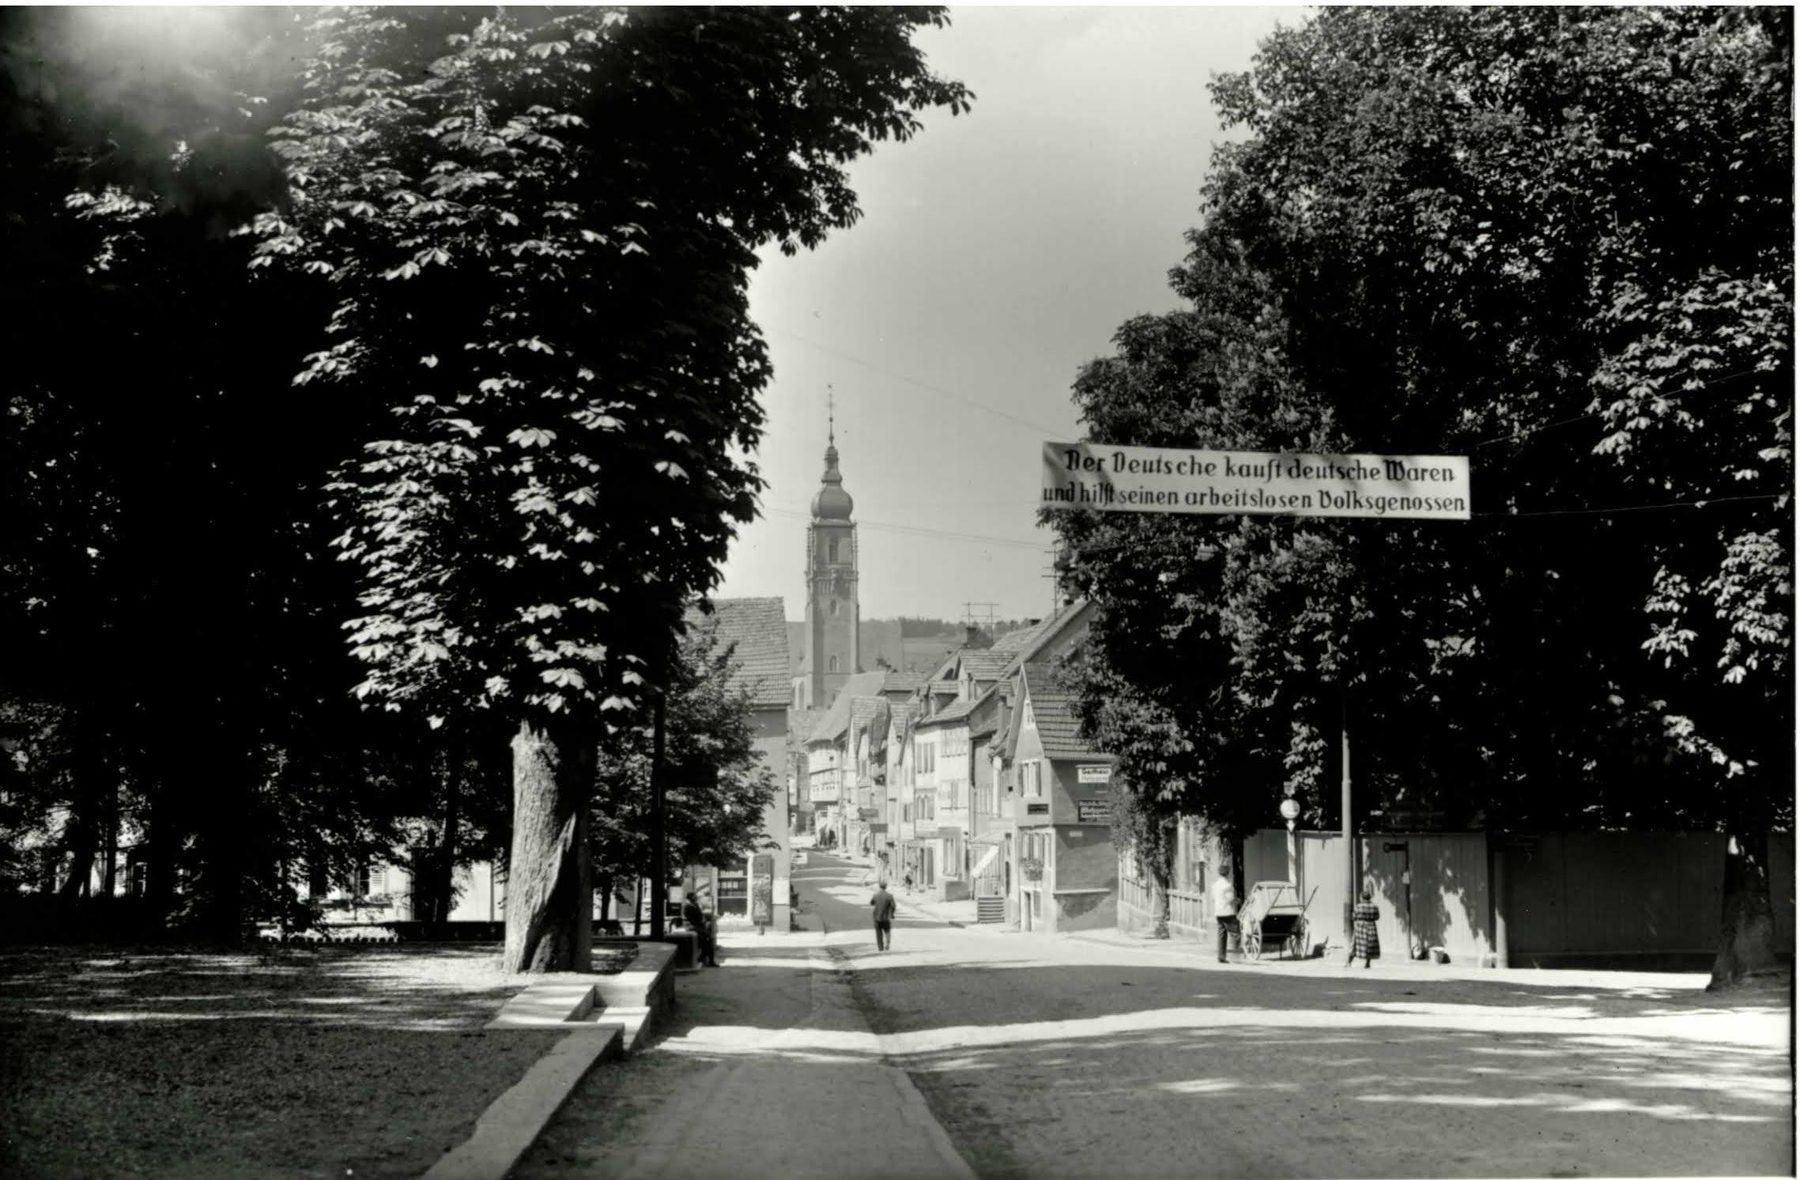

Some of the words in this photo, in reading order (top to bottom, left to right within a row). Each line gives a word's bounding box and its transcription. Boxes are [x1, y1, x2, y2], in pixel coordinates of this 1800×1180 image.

[1064, 449, 1105, 472] Der
[1112, 451, 1217, 476] Deutsche
[1225, 455, 1281, 483] kauft
[1287, 458, 1381, 480] deutsche
[1382, 459, 1454, 481] Waren
[1043, 482, 1075, 502] und
[1080, 482, 1115, 506] hilft
[1118, 485, 1179, 505] seinen
[1185, 486, 1312, 508] arbeitslosen
[1317, 490, 1465, 515] Volksgenossen
